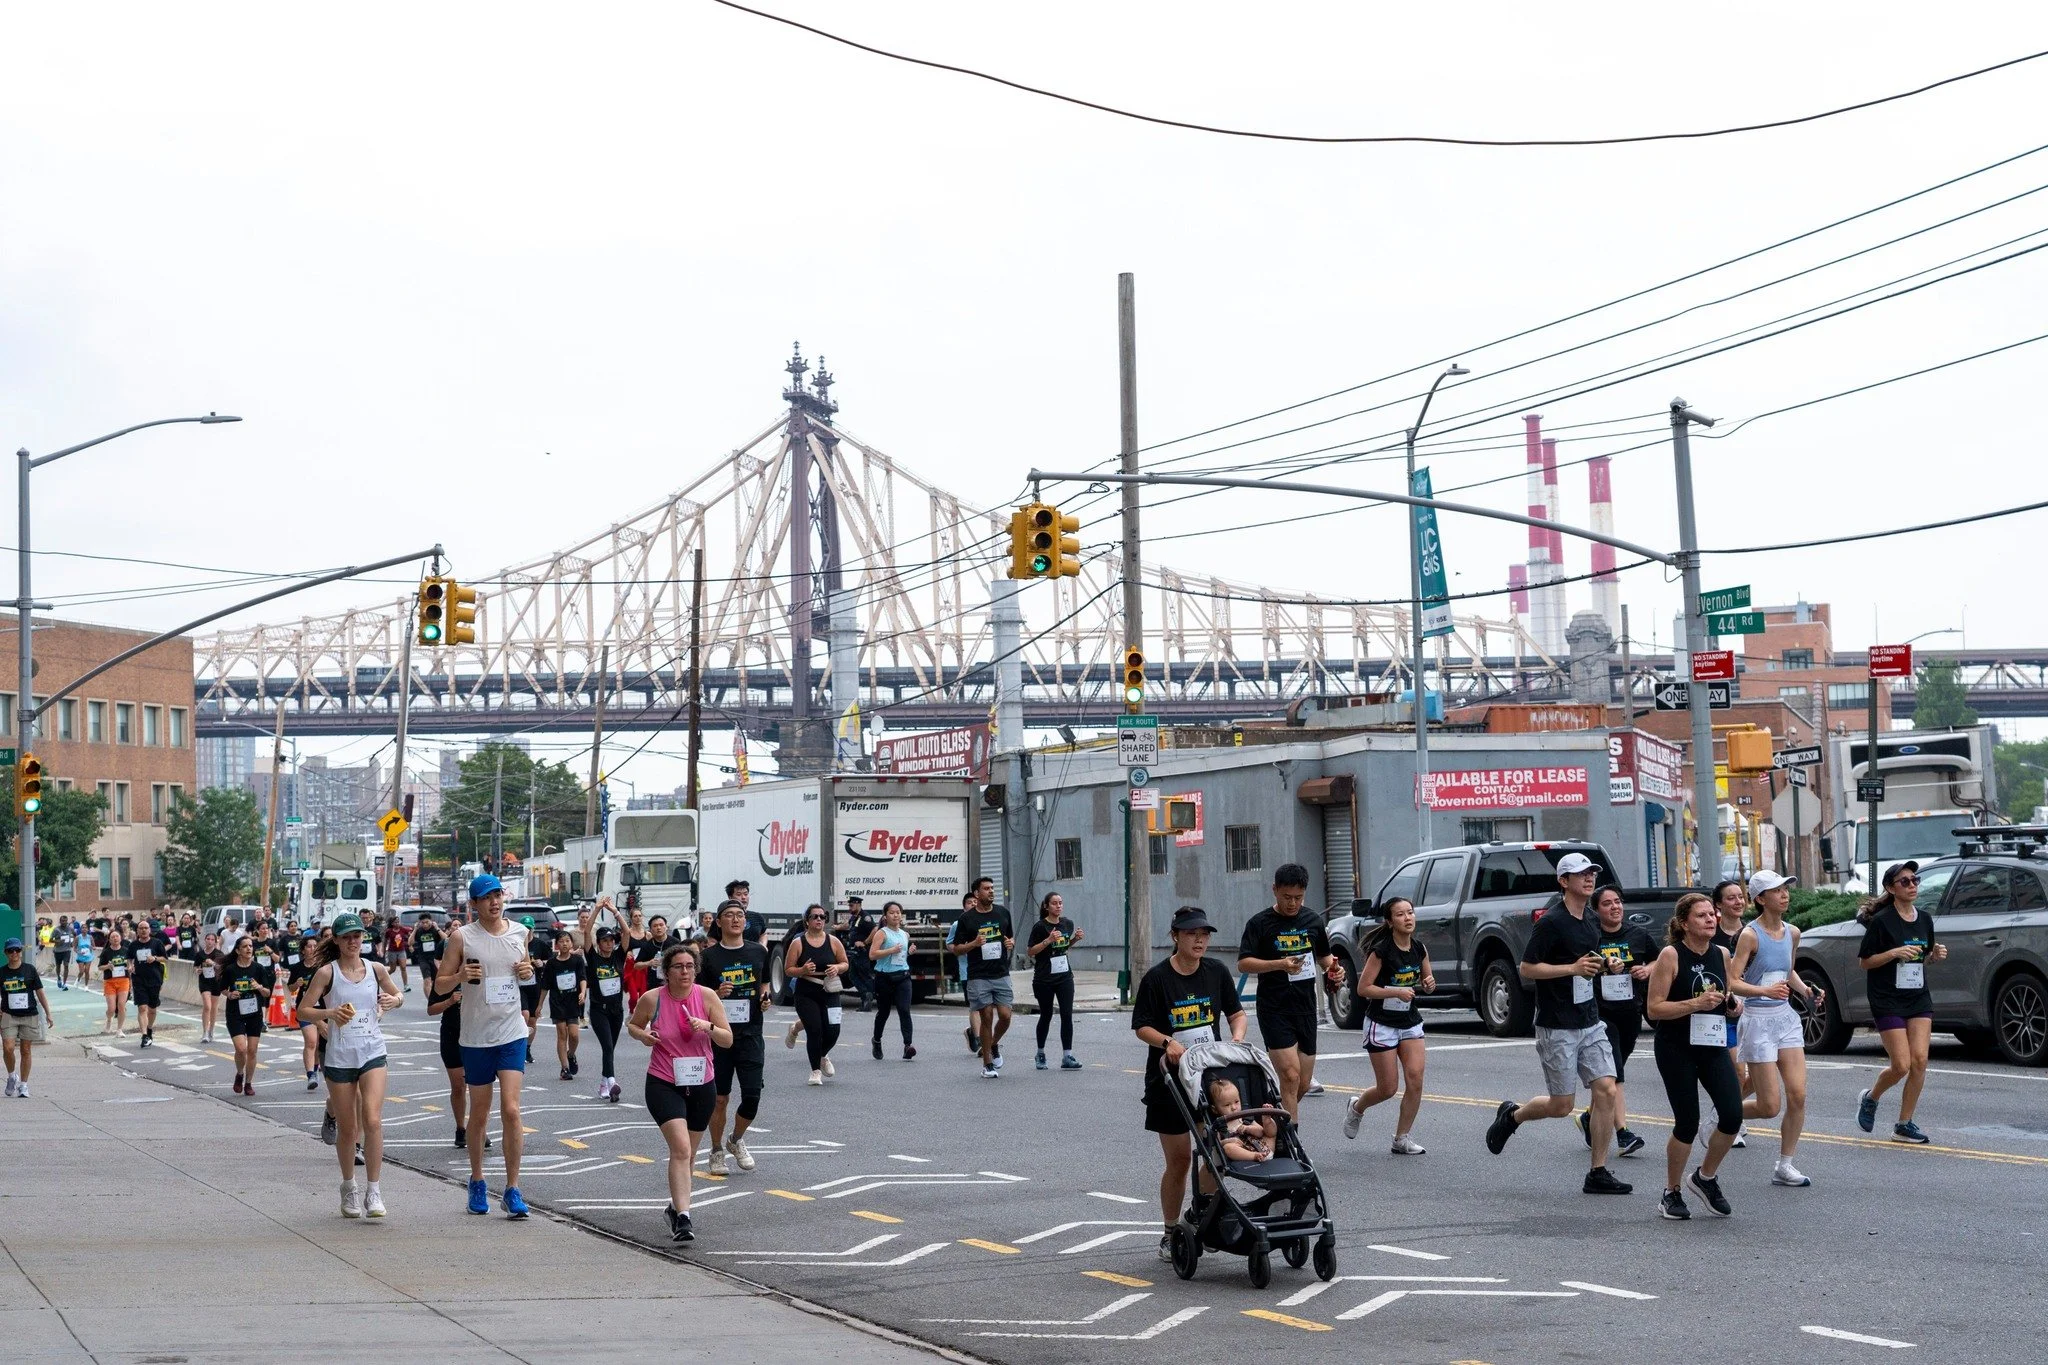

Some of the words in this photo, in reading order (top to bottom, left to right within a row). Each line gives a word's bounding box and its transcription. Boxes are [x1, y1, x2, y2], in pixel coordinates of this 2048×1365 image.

[1420, 528, 1438, 556] LIC
[1701, 593, 1733, 612] Vernon
[1736, 587, 1750, 600] Blvd
[1718, 617, 1735, 632] 44
[1741, 615, 1753, 626] Rd
[1880, 646, 1906, 654] STANDING
[1702, 652, 1728, 660] STANDING
[1871, 656, 1893, 664] Anytime
[1694, 660, 1717, 669] Anytime
[1665, 690, 1688, 702] ONE
[1708, 690, 1725, 701] AY
[1120, 718, 1133, 726] BIKE
[893, 739, 918, 760] MOVIL
[918, 734, 940, 757] AUTO
[940, 730, 971, 754] GLASS
[1121, 744, 1156, 752] SHARED
[1127, 754, 1149, 762] LANE
[1774, 756, 1790, 765] ONE
[1798, 752, 1815, 760] WAY
[1504, 769, 1534, 785] FOR
[1538, 768, 1586, 784] LEASE
[1474, 785, 1523, 795] CONTACT
[839, 801, 889, 813] Ryder.com
[386, 838, 396, 846] 15
[769, 820, 810, 864] Ryder
[868, 829, 949, 856] Ryder
[899, 852, 923, 863] Ever
[924, 852, 958, 863] better.
[783, 858, 796, 876] Ever
[796, 856, 814, 875] better.
[917, 876, 936, 884] TRUCK
[937, 876, 959, 884] RENTAL
[1711, 1024, 1722, 1032] 439
[1194, 1036, 1209, 1044] 1783
